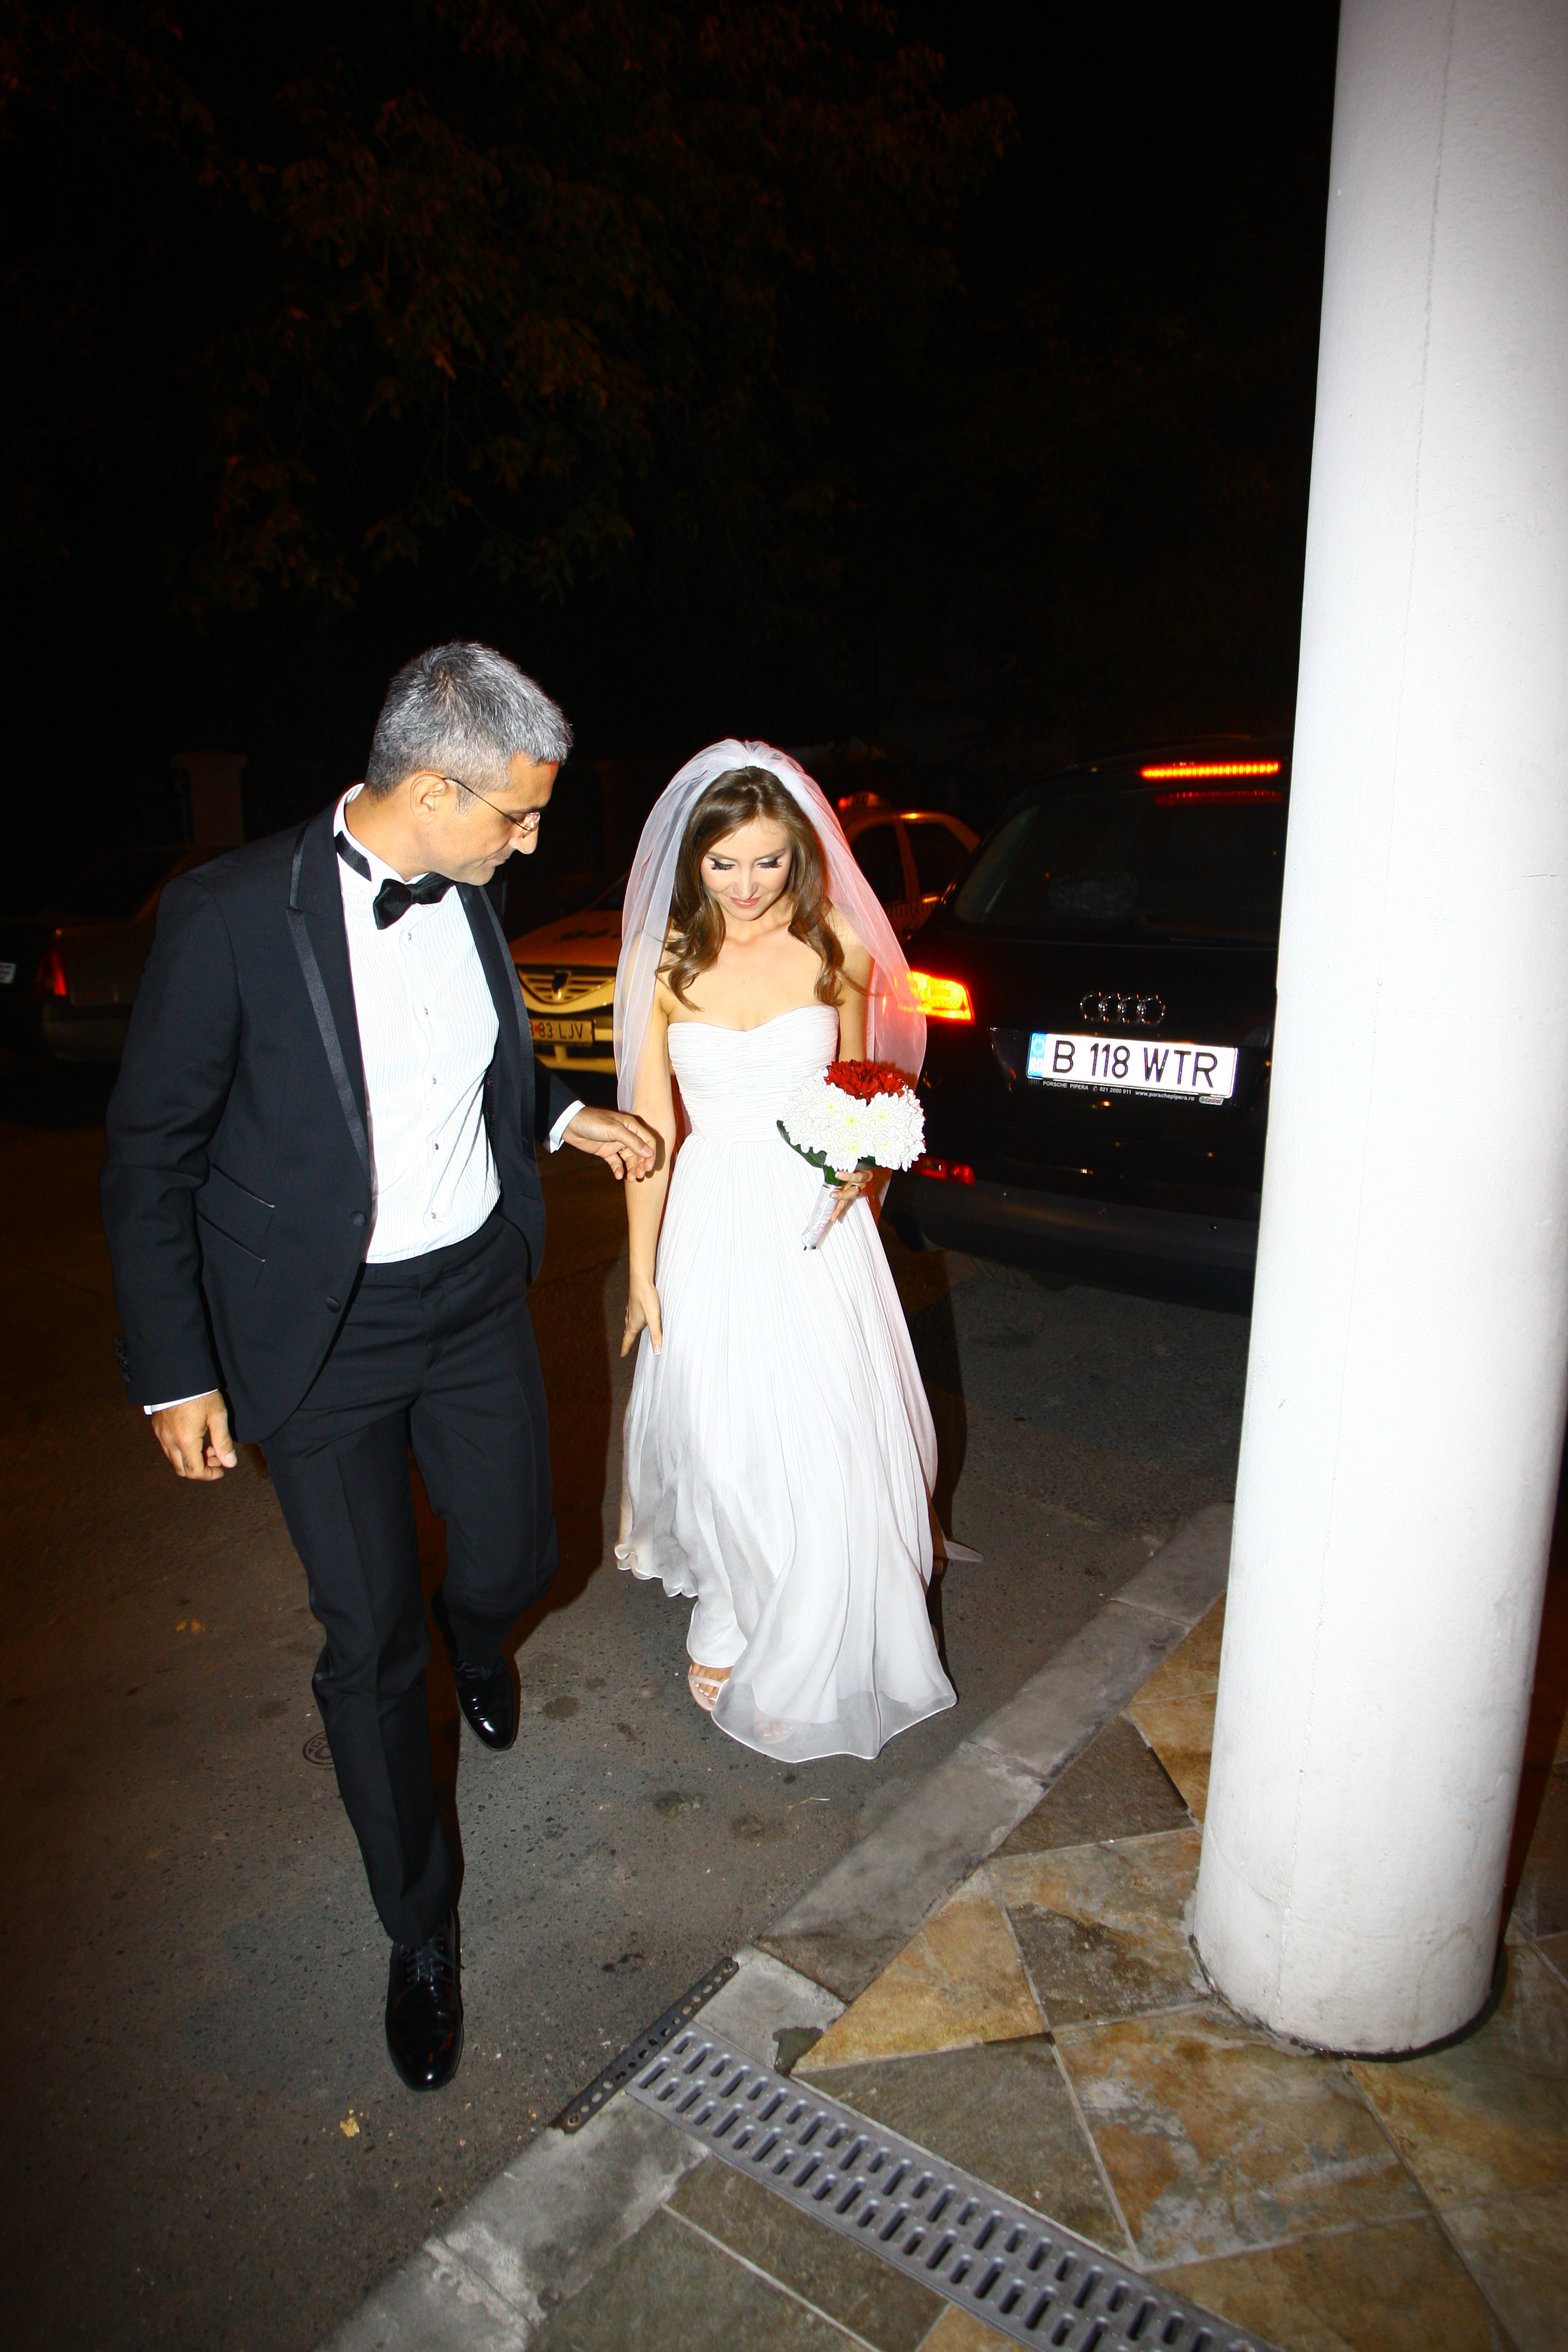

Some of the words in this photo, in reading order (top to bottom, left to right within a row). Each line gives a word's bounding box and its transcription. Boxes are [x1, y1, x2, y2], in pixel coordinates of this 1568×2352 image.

[538, 1022, 553, 1038] 83
[558, 1022, 583, 1039] LJV
[1029, 1057, 1044, 1073] RO
[1053, 1040, 1075, 1073] B
[1090, 1043, 1130, 1079] 118
[1144, 1047, 1218, 1088] WTR
